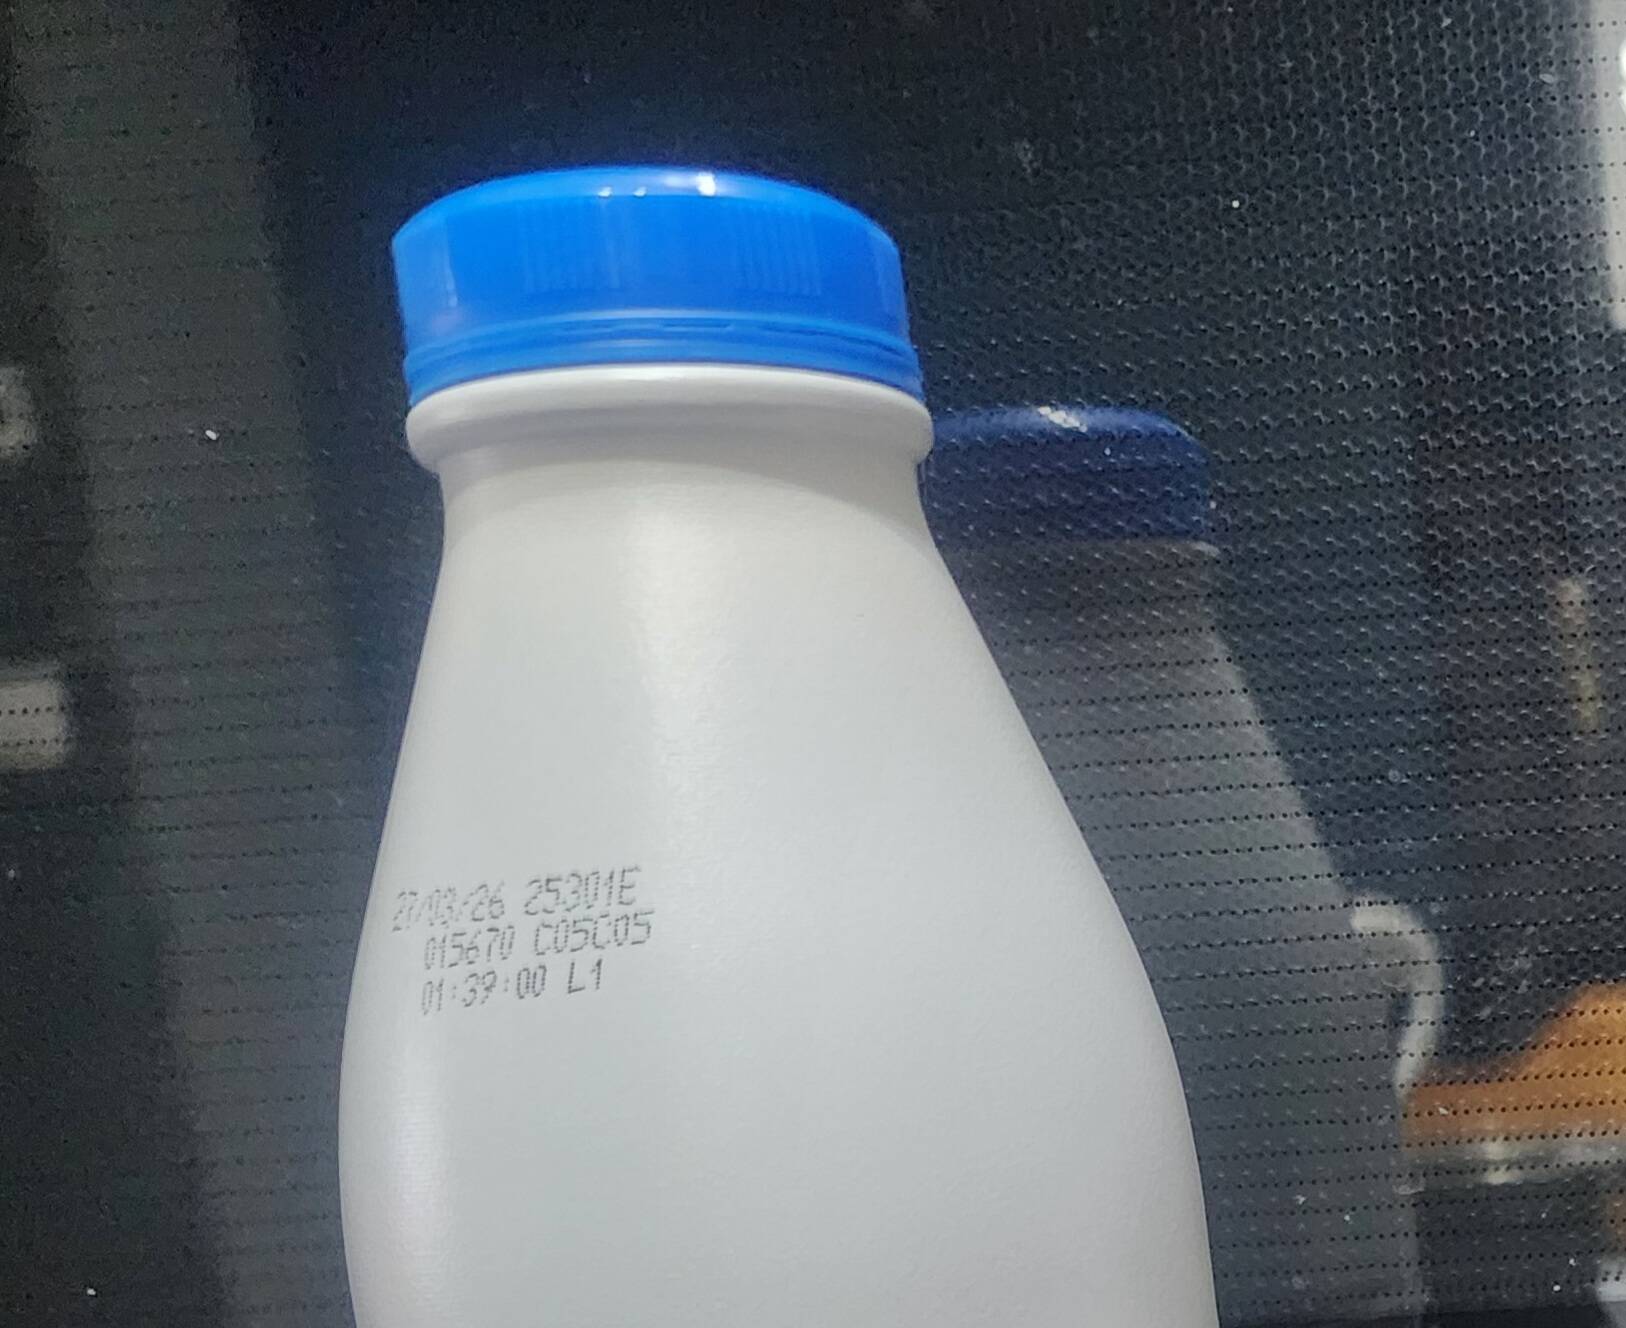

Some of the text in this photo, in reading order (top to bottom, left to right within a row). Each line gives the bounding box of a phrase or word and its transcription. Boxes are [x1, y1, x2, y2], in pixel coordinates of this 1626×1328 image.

[524, 865, 641, 915] 25301E
[424, 909, 655, 970] 015670 C05C05
[422, 958, 603, 1016] 01:39:00 L1
